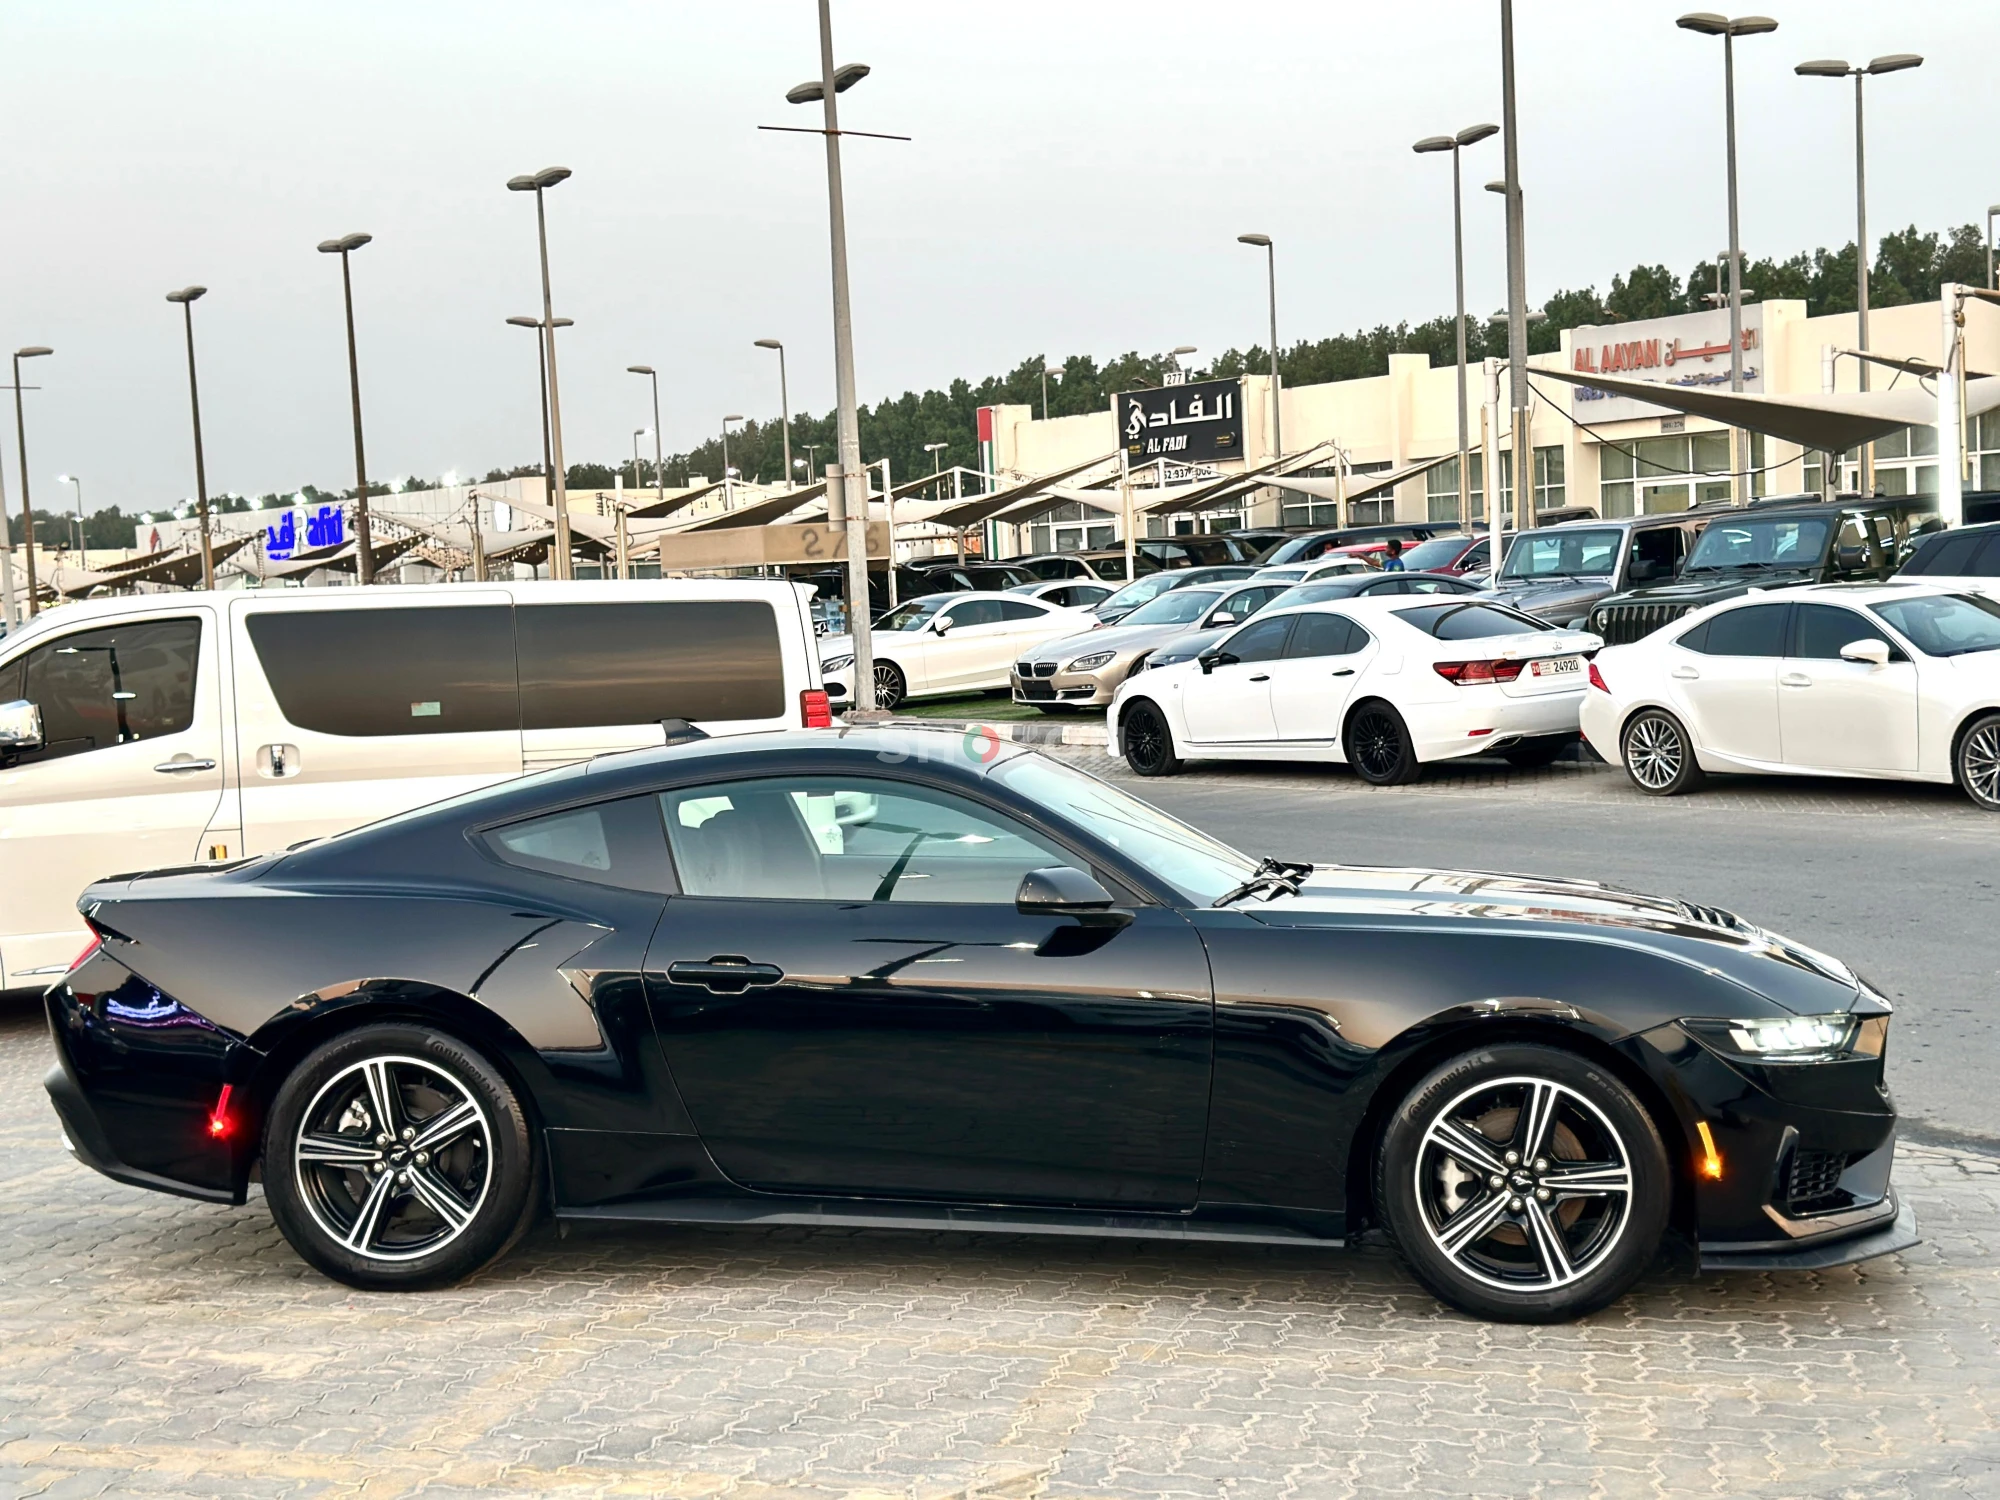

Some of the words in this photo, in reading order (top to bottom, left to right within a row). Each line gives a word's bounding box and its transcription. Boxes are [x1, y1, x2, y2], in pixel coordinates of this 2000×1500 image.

[1574, 348, 1597, 374] AL
[1600, 338, 1661, 374] AAYAN
[1166, 373, 1183, 385] 277
[1125, 392, 1233, 440] الفادي
[1147, 438, 1161, 453] AL
[1162, 434, 1188, 452] FADI
[1552, 659, 1579, 673] 24920
